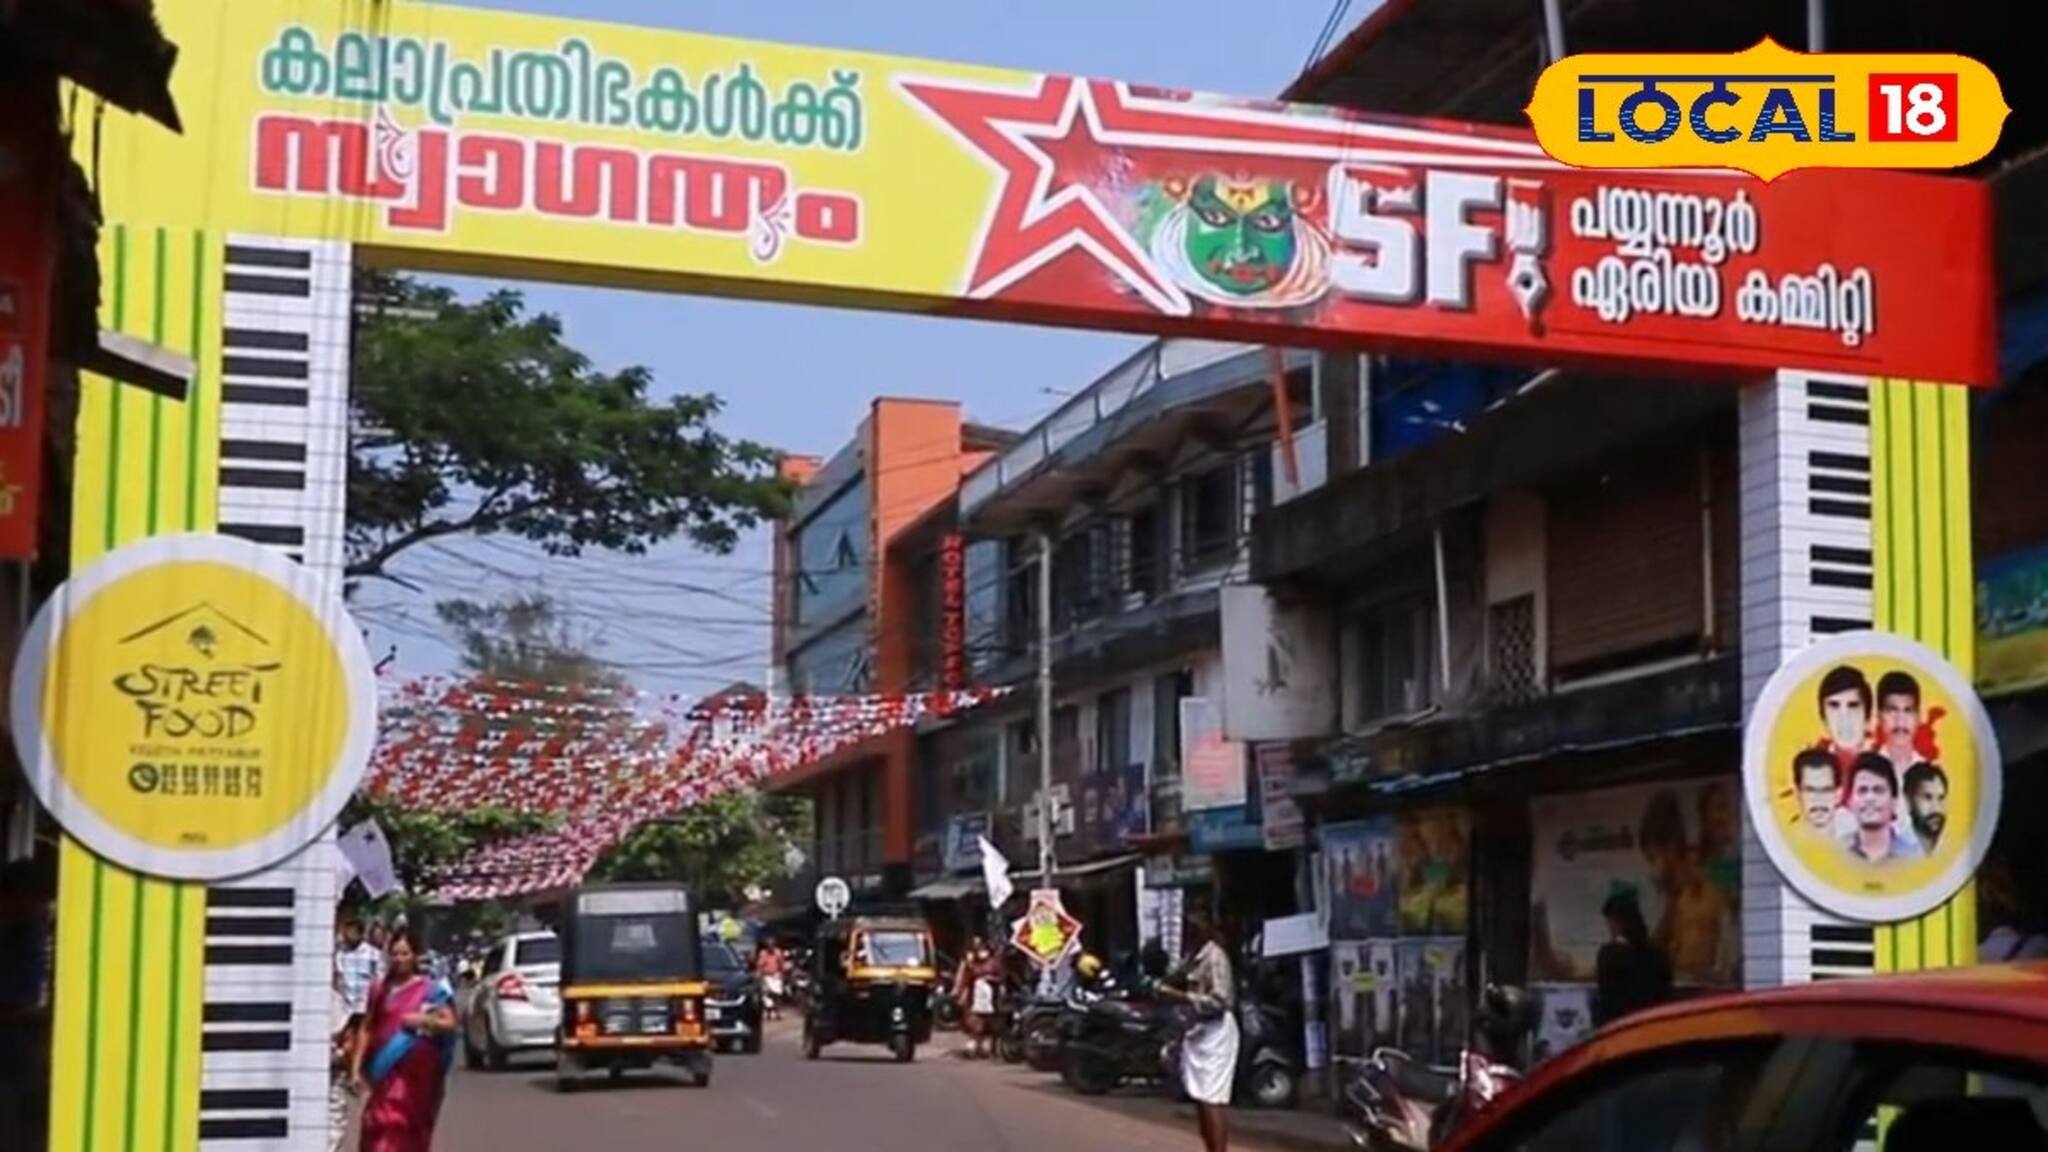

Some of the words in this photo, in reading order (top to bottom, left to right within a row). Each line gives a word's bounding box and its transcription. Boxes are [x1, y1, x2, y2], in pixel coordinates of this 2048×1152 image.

[255, 110, 861, 259] സ്വാഗതം
[1571, 253, 1720, 323] ഏരിയ
[1736, 264, 1876, 346] കമ്മിറ്റി
[113, 663, 283, 703] STREET
[137, 701, 257, 739] FOOD
